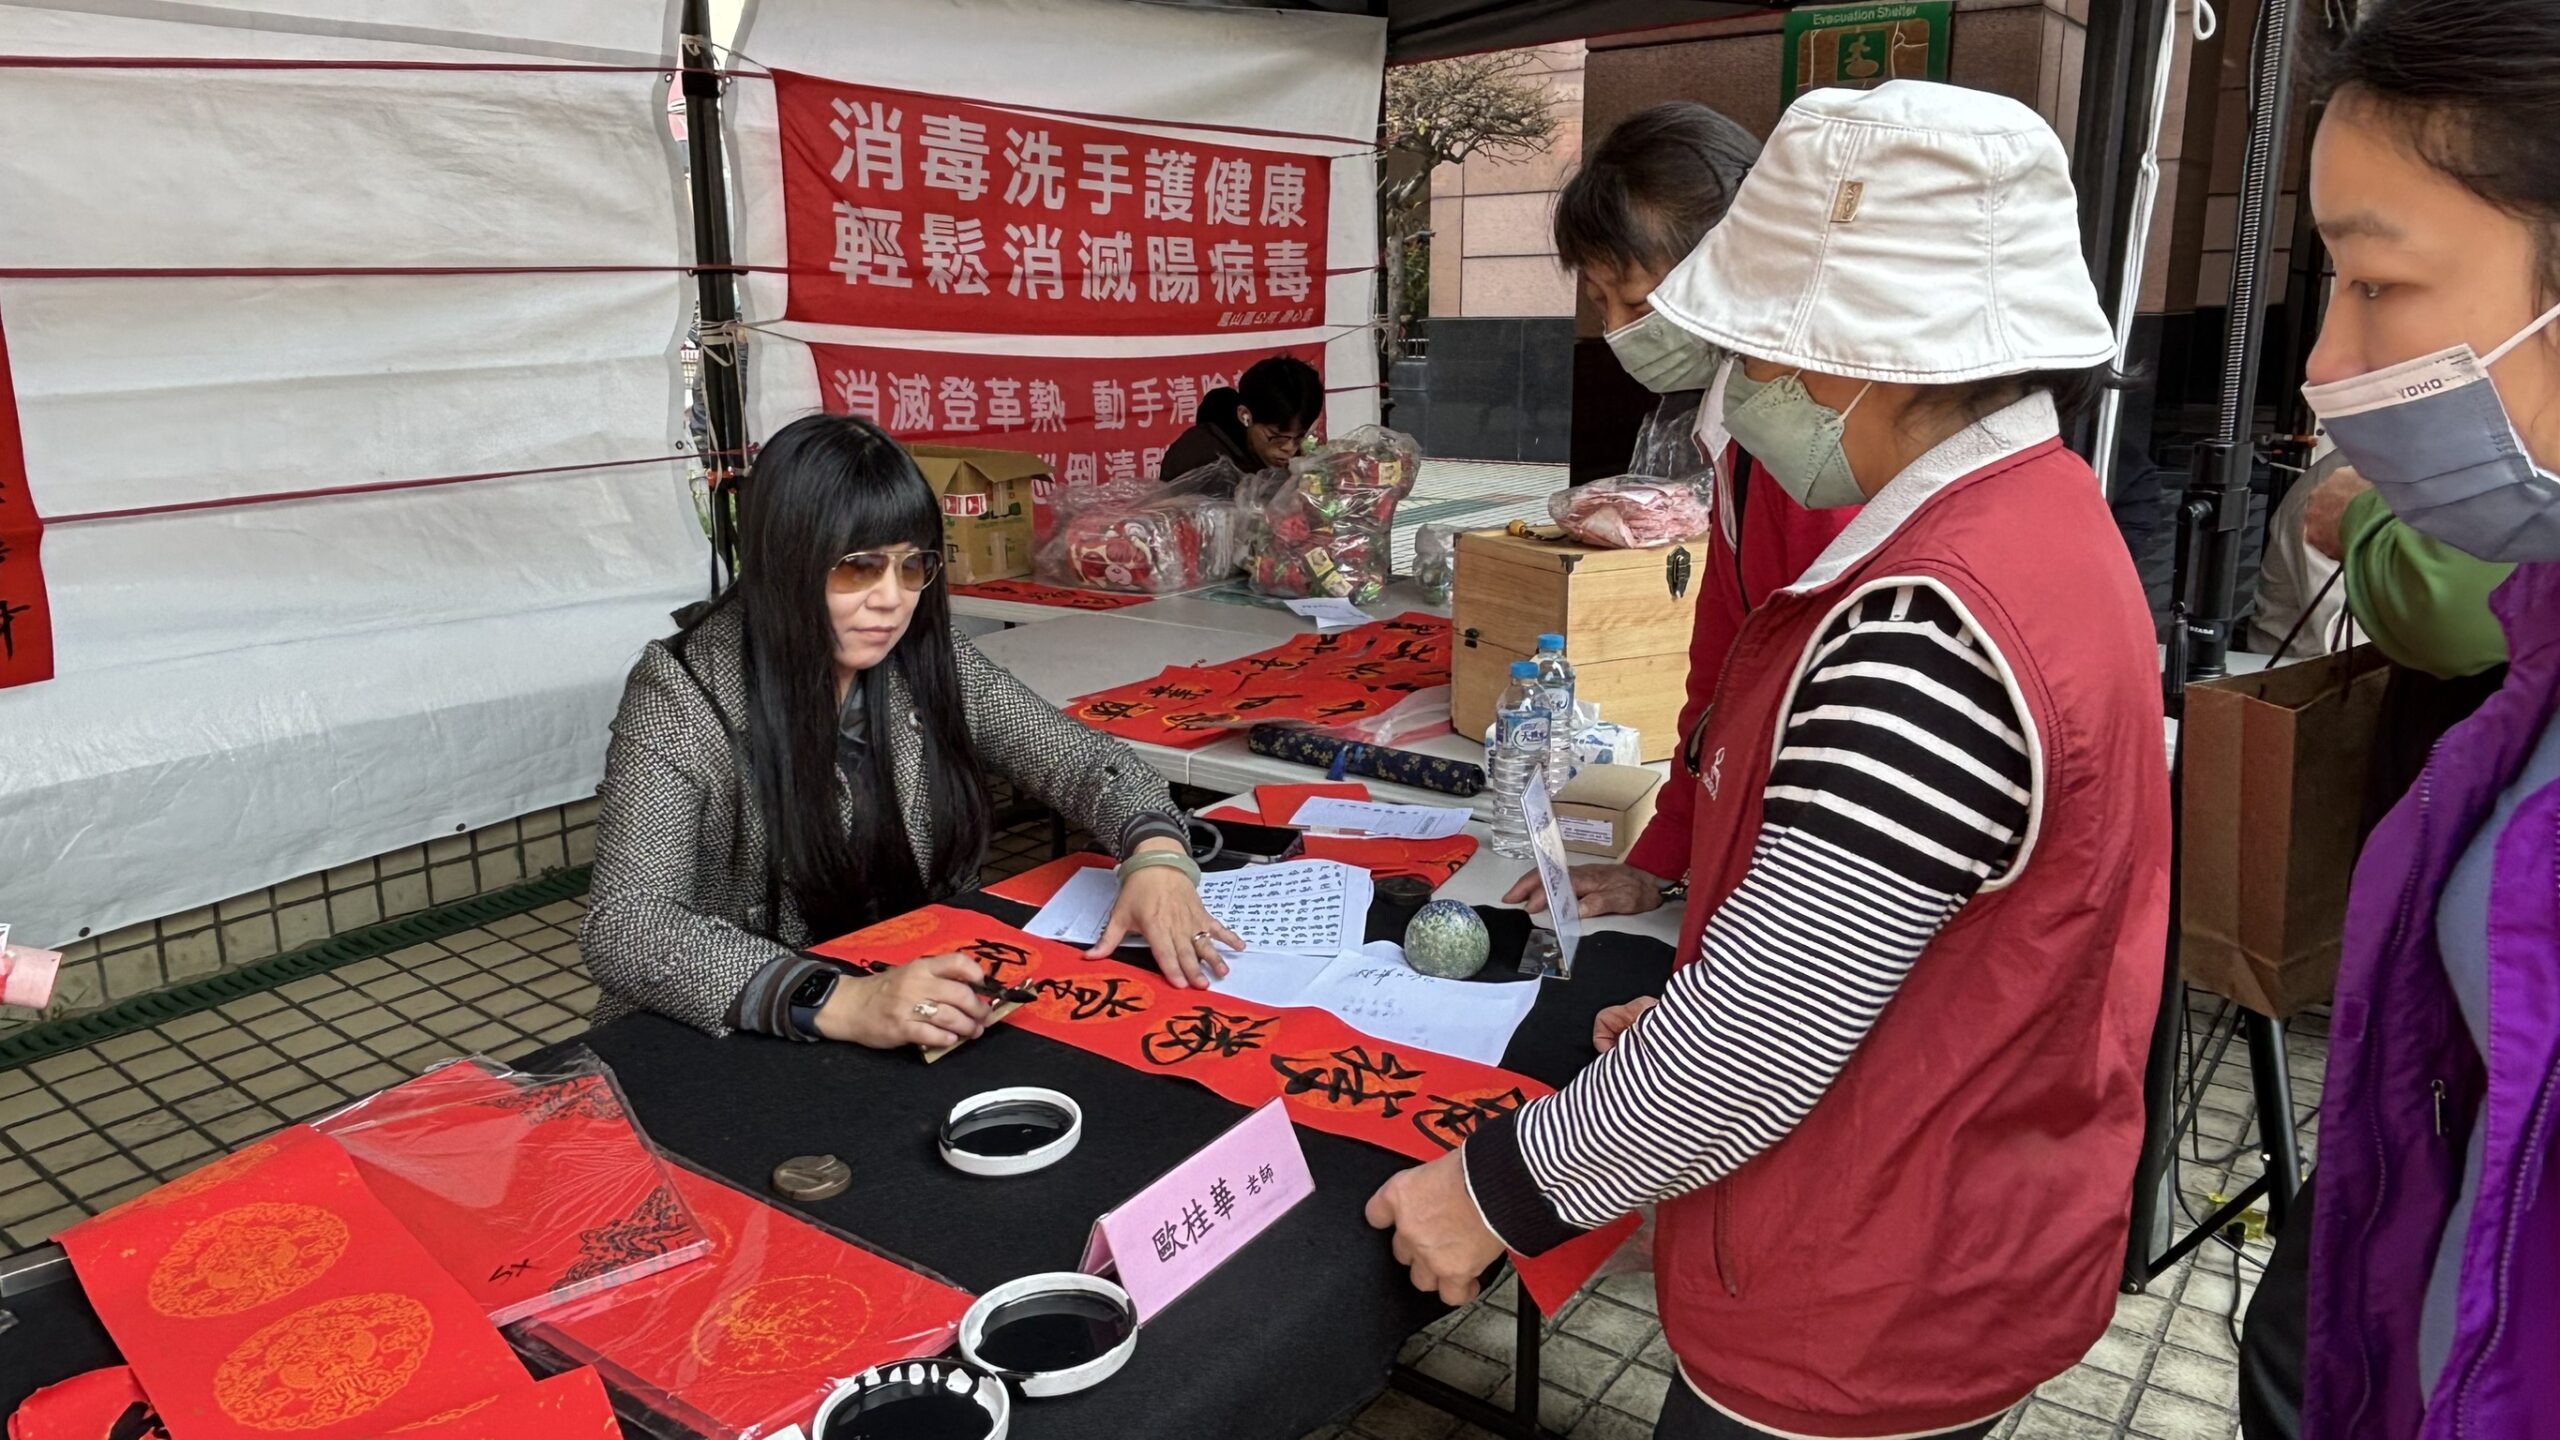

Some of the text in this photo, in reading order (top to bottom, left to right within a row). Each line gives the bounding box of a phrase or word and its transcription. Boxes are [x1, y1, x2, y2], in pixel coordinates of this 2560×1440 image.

[1813, 5, 1918, 25] Evacuation Shelter
[829, 96, 1308, 228] 消毒洗手護健康
[828, 200, 1313, 304] 輕鬆消滅腸病毒
[834, 370, 1068, 432] 消滅登革熱
[2397, 378, 2443, 399] YOHO
[1152, 1163, 1275, 1263] 歐桂華 老師
